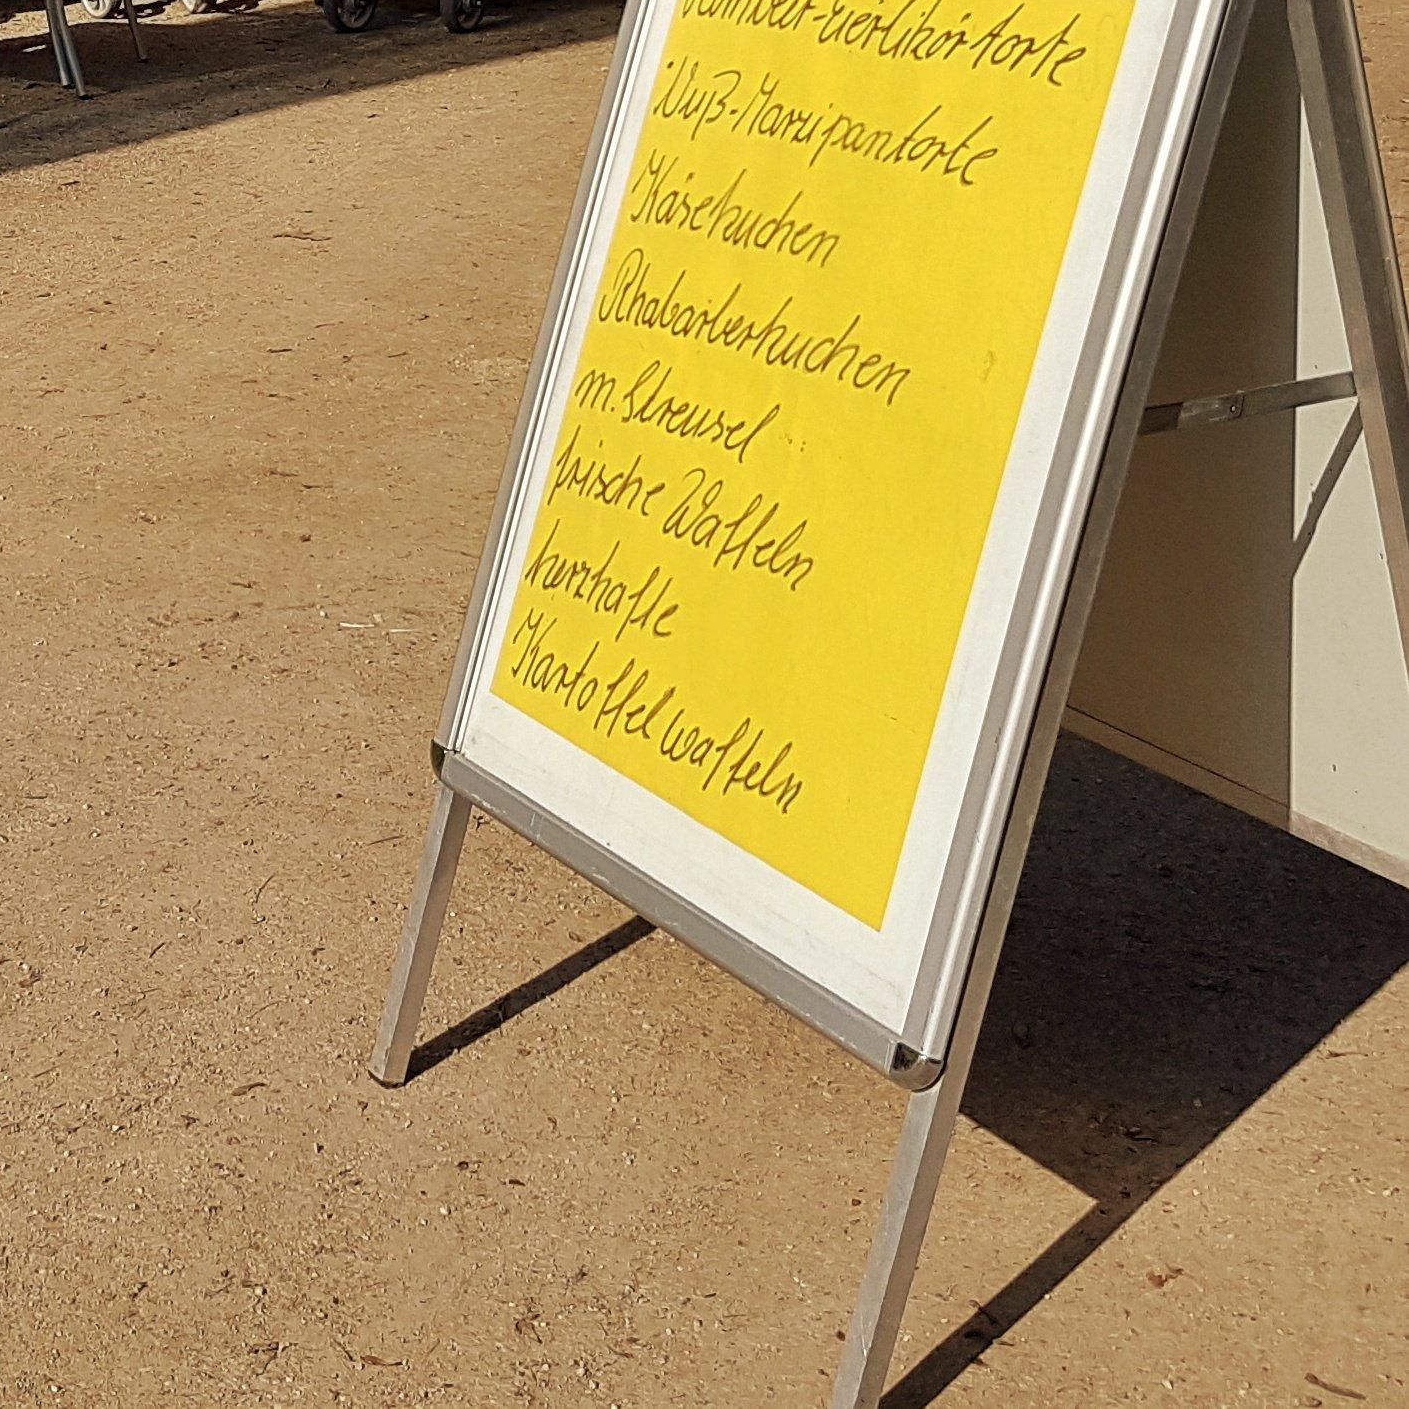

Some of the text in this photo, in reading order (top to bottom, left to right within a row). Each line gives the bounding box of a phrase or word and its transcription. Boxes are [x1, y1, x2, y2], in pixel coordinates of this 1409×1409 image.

[653, 56, 1000, 186] Nuß-Marzipantorte
[629, 149, 840, 268] Käsekuchen
[597, 247, 911, 406] Rhabarberkuchen
[574, 359, 780, 463] m. Streusel
[547, 425, 815, 592] frische Waffeln
[524, 519, 681, 642] herzhafte
